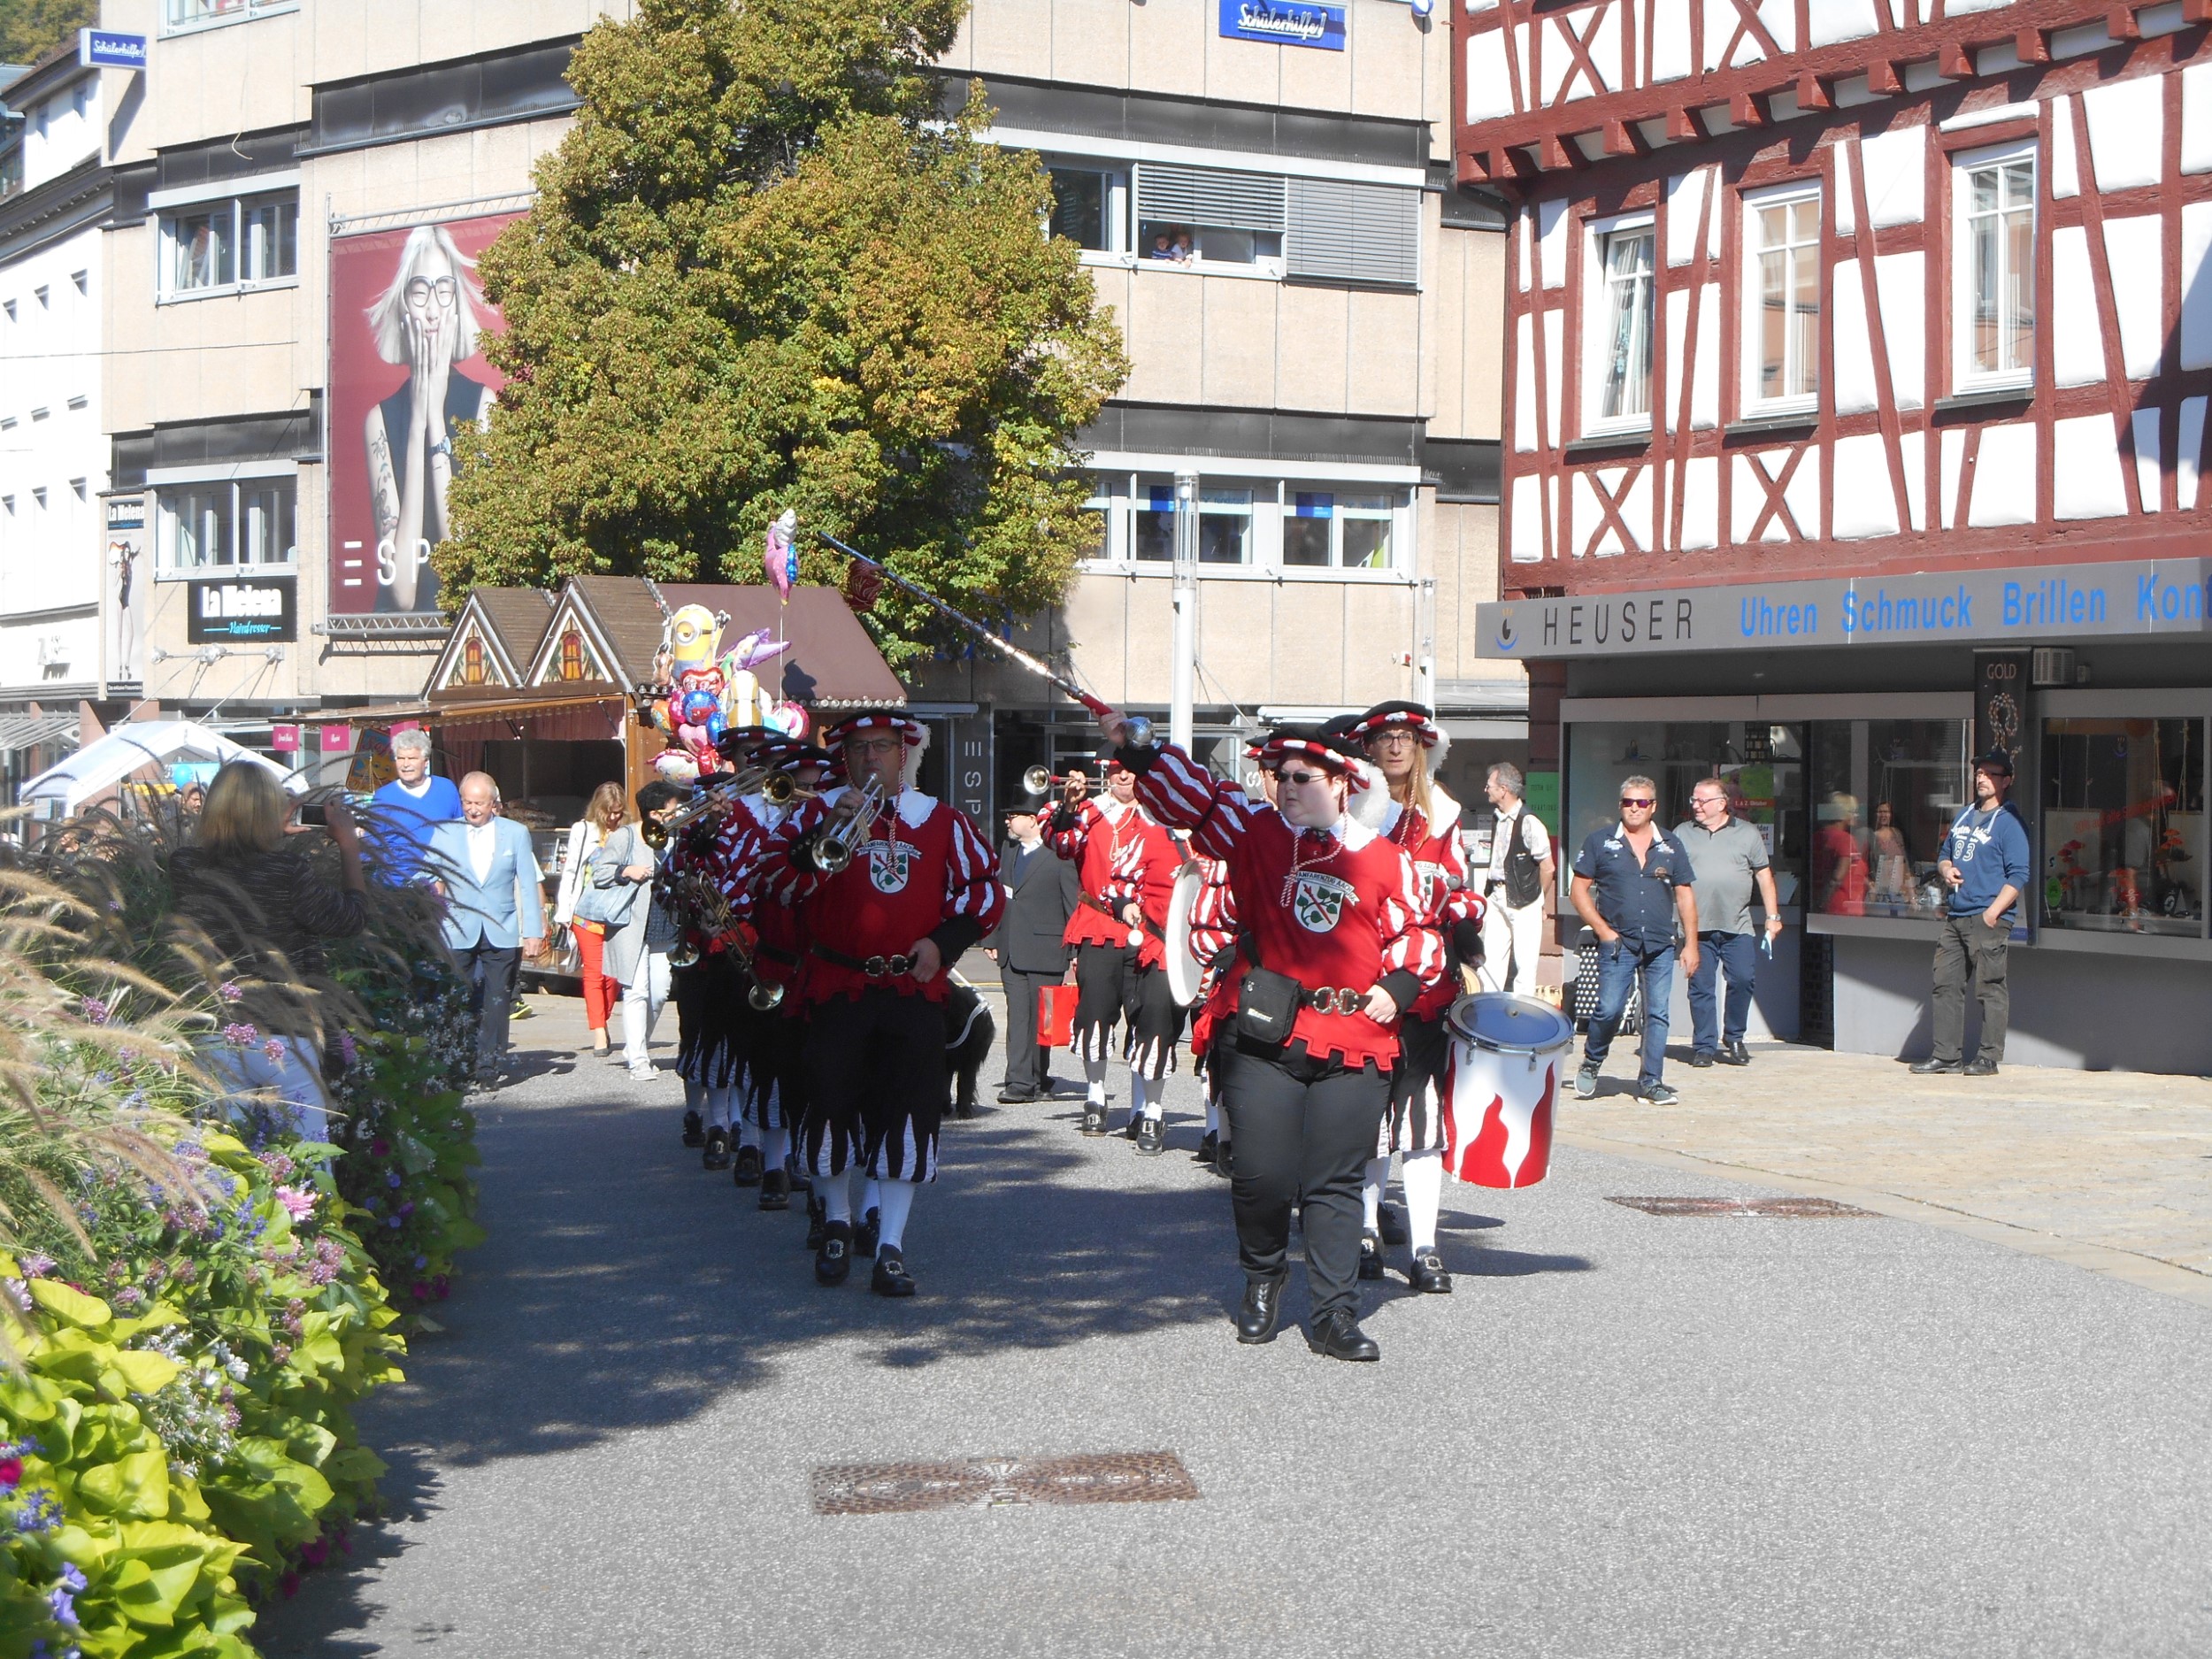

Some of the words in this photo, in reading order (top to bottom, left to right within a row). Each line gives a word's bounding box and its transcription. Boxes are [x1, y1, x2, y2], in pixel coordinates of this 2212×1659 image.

[108, 505, 117, 521] La
[203, 586, 220, 618] La
[1544, 598, 1692, 645] HEUSER
[1740, 595, 1817, 637] Uhren
[1841, 584, 1973, 633] Schmuck
[2002, 579, 2107, 626] Brillen
[1987, 664, 2016, 680] GOLD
[1953, 840, 1976, 862] 83
